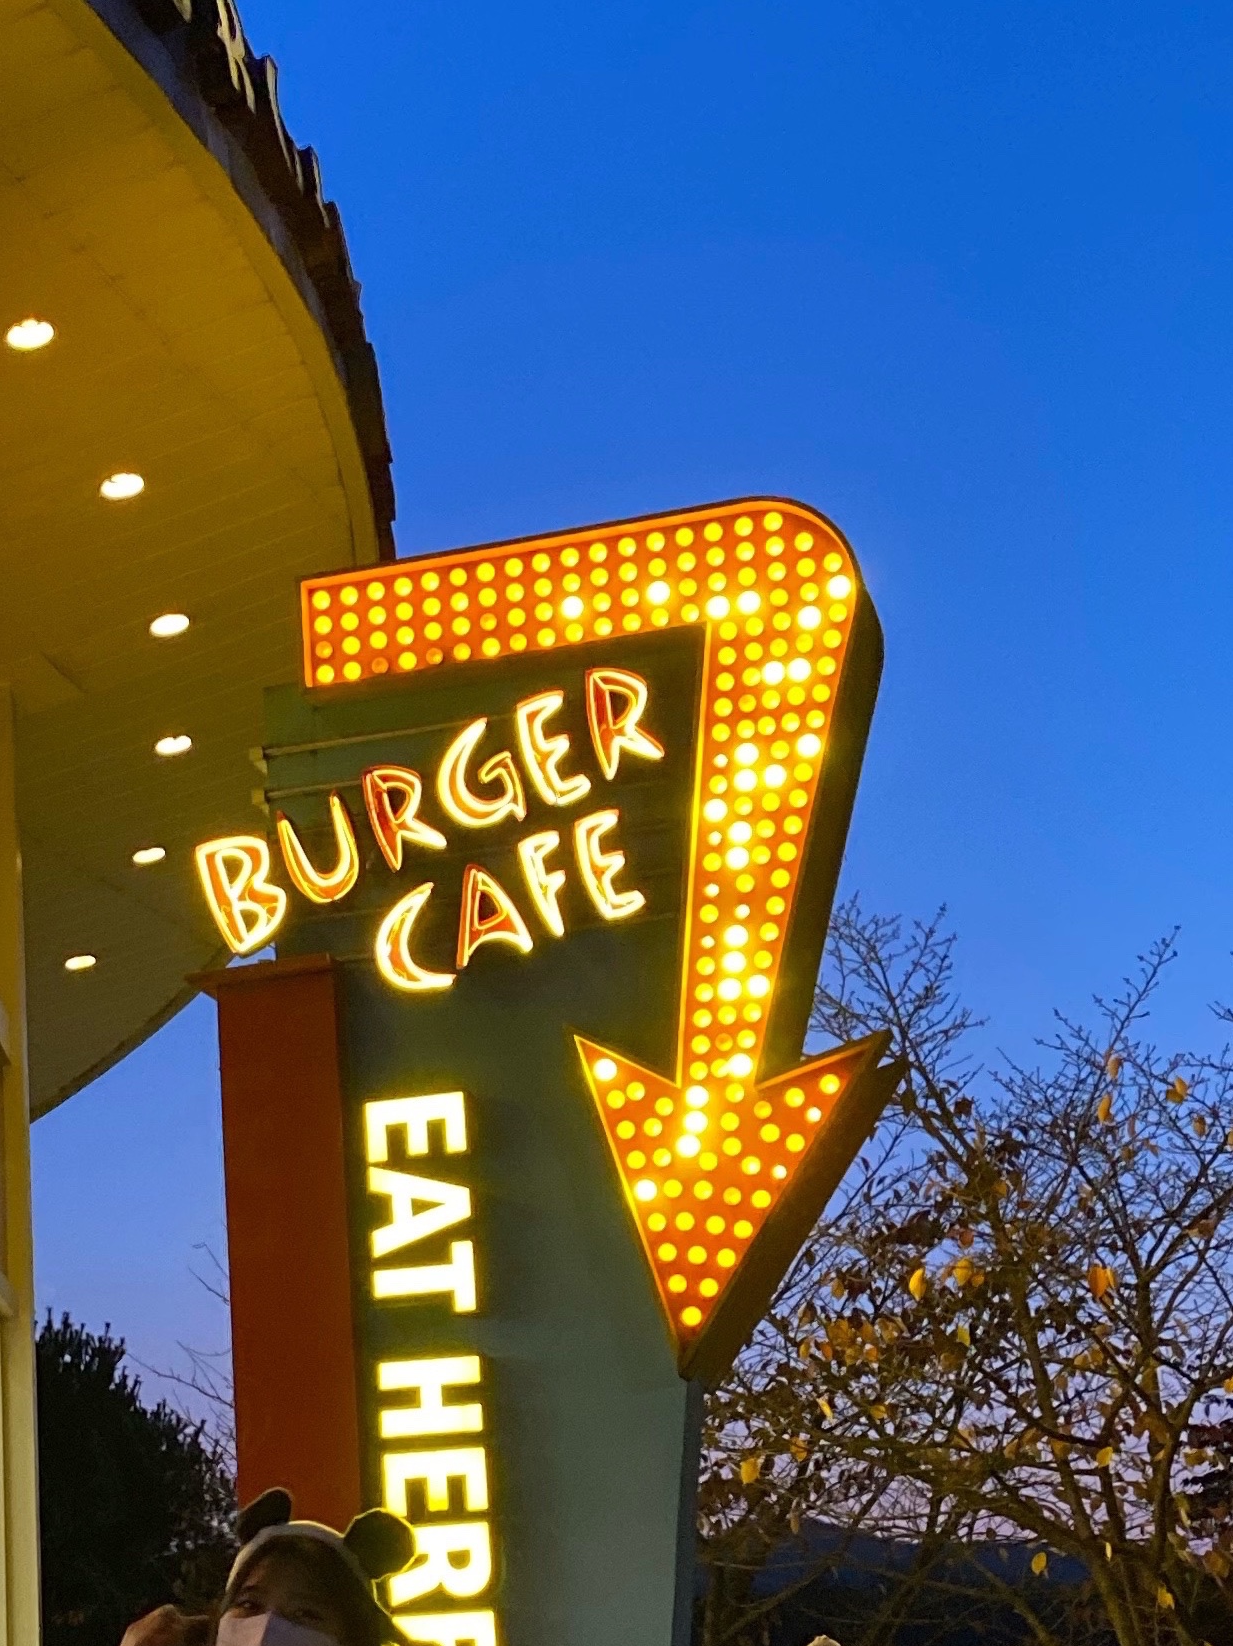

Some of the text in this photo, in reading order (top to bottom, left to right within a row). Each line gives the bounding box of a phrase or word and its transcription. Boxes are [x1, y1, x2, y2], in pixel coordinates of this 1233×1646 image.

[195, 668, 664, 954] BURGER
[375, 809, 646, 991] CAFE
[365, 1091, 477, 1314] EAT
